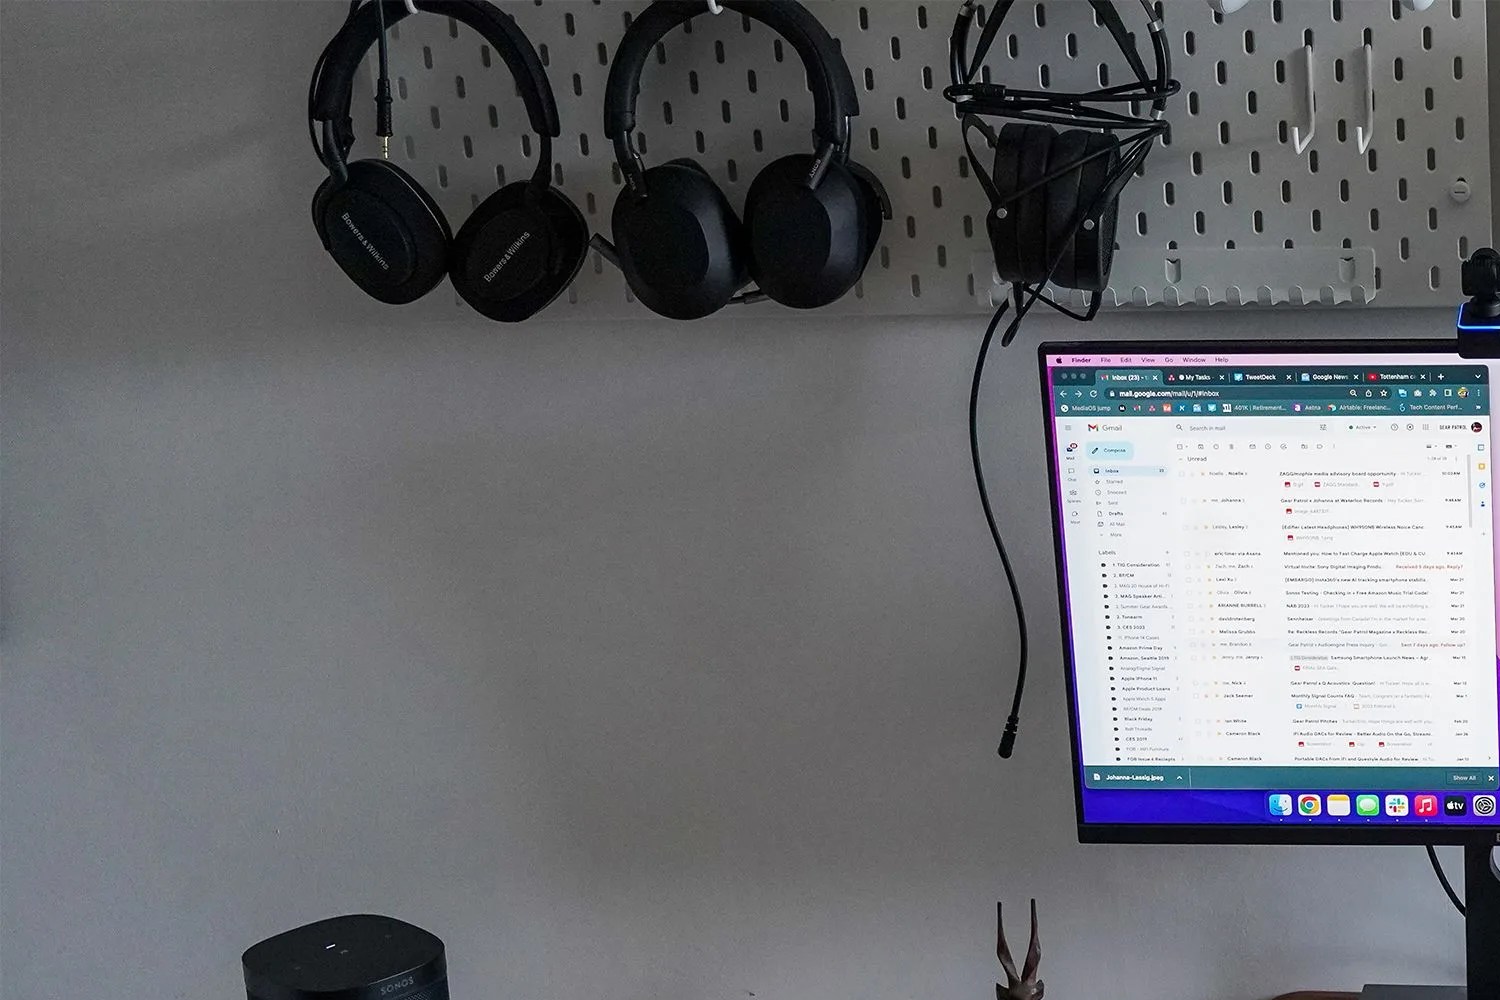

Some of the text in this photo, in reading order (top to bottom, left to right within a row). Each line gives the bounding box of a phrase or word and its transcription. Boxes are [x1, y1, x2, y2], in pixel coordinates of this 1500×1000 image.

[341, 211, 390, 271] Bowers & Wilkins
[483, 231, 531, 283] Bowers & Wilkins
[1128, 374, 1140, 382] (23)
[1185, 374, 1194, 382] My
[1245, 373, 1277, 381] TweetDeck
[1312, 373, 1333, 382] Google
[1102, 424, 1123, 432] Gmail
[1106, 774, 1164, 782] Johanna-Lassig.jpeg
[1454, 801, 1464, 810] tv
[380, 976, 414, 996] SONOS
